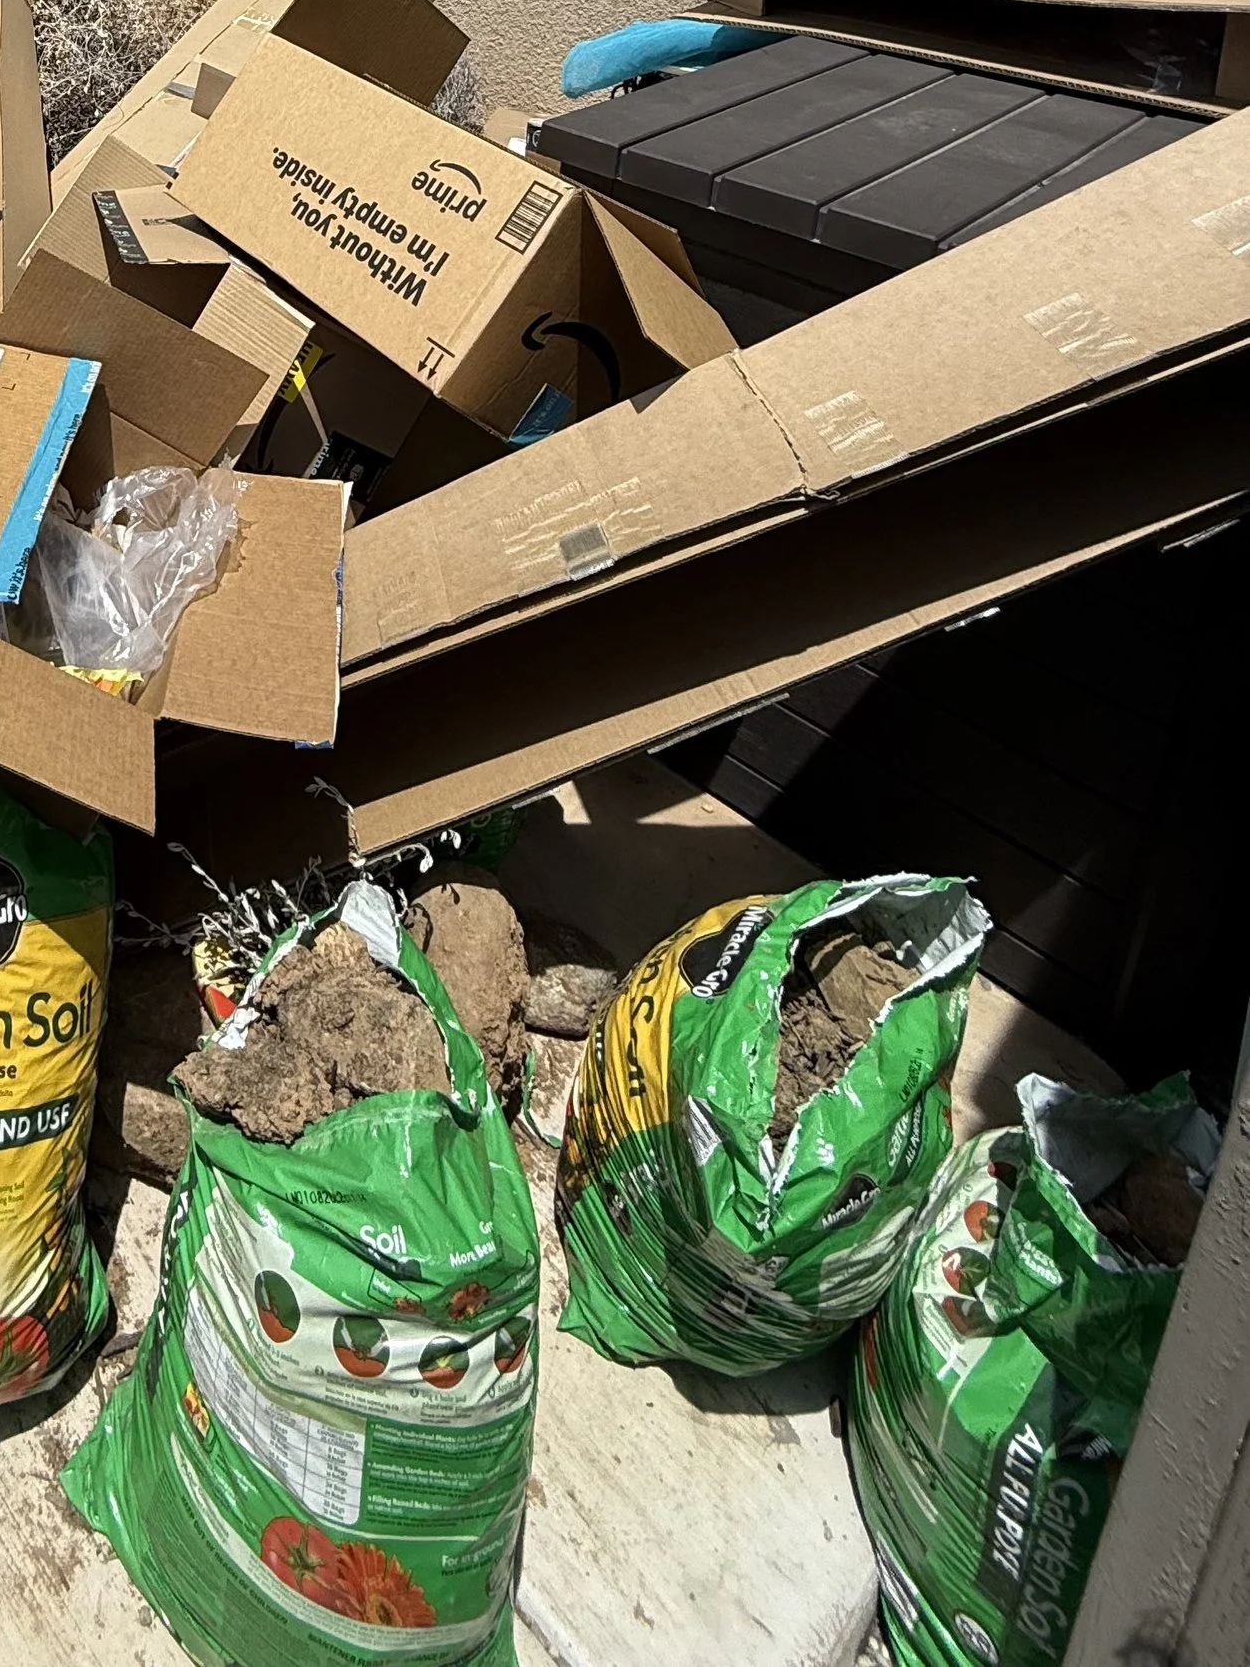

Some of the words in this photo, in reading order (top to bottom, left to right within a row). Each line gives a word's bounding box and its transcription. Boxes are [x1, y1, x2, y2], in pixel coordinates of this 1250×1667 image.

[272, 147, 336, 206] inside.
[411, 171, 487, 222] prime
[291, 192, 338, 231] you,
[335, 187, 408, 244] empty
[330, 225, 427, 307] Without
[407, 234, 450, 277] I'm
[691, 905, 768, 999] Miracle-Gro
[23, 979, 94, 1048] Soil
[37, 1103, 70, 1133] USE
[359, 1224, 409, 1255] Soil
[1003, 1422, 1044, 1476] ALL
[992, 1470, 1031, 1582] PUPOSE
[1028, 1476, 1091, 1599] Garden
